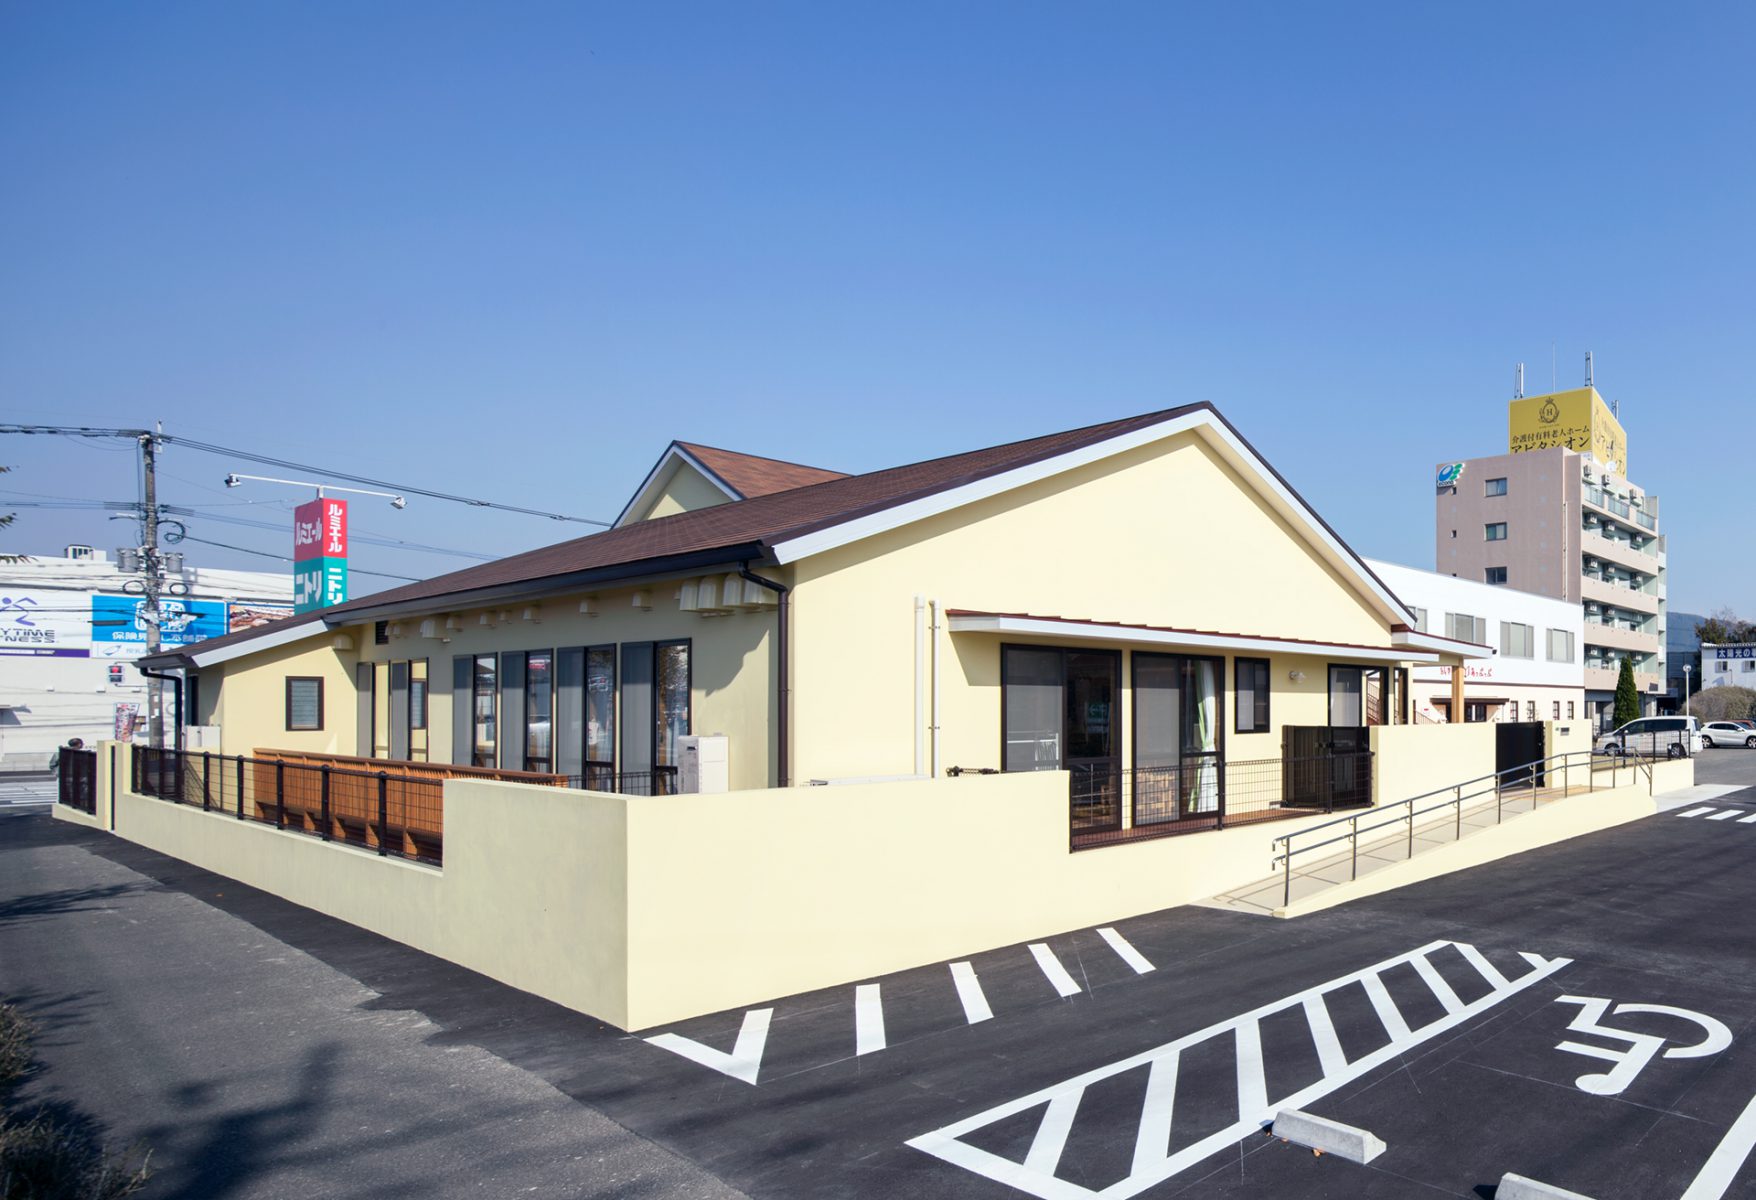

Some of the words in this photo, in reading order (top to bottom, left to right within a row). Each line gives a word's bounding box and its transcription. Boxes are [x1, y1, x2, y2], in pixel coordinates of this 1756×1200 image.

[1511, 437, 1590, 454] アビタシオン
[1512, 425, 1590, 445] 介護付有料老人ホーム
[295, 517, 323, 546] ルミエール
[328, 503, 343, 553] ルミエール
[295, 570, 323, 605] ニトリ
[328, 567, 343, 605] ニトリ
[0, 628, 55, 637] YTIME
[0, 635, 56, 644] NESS
